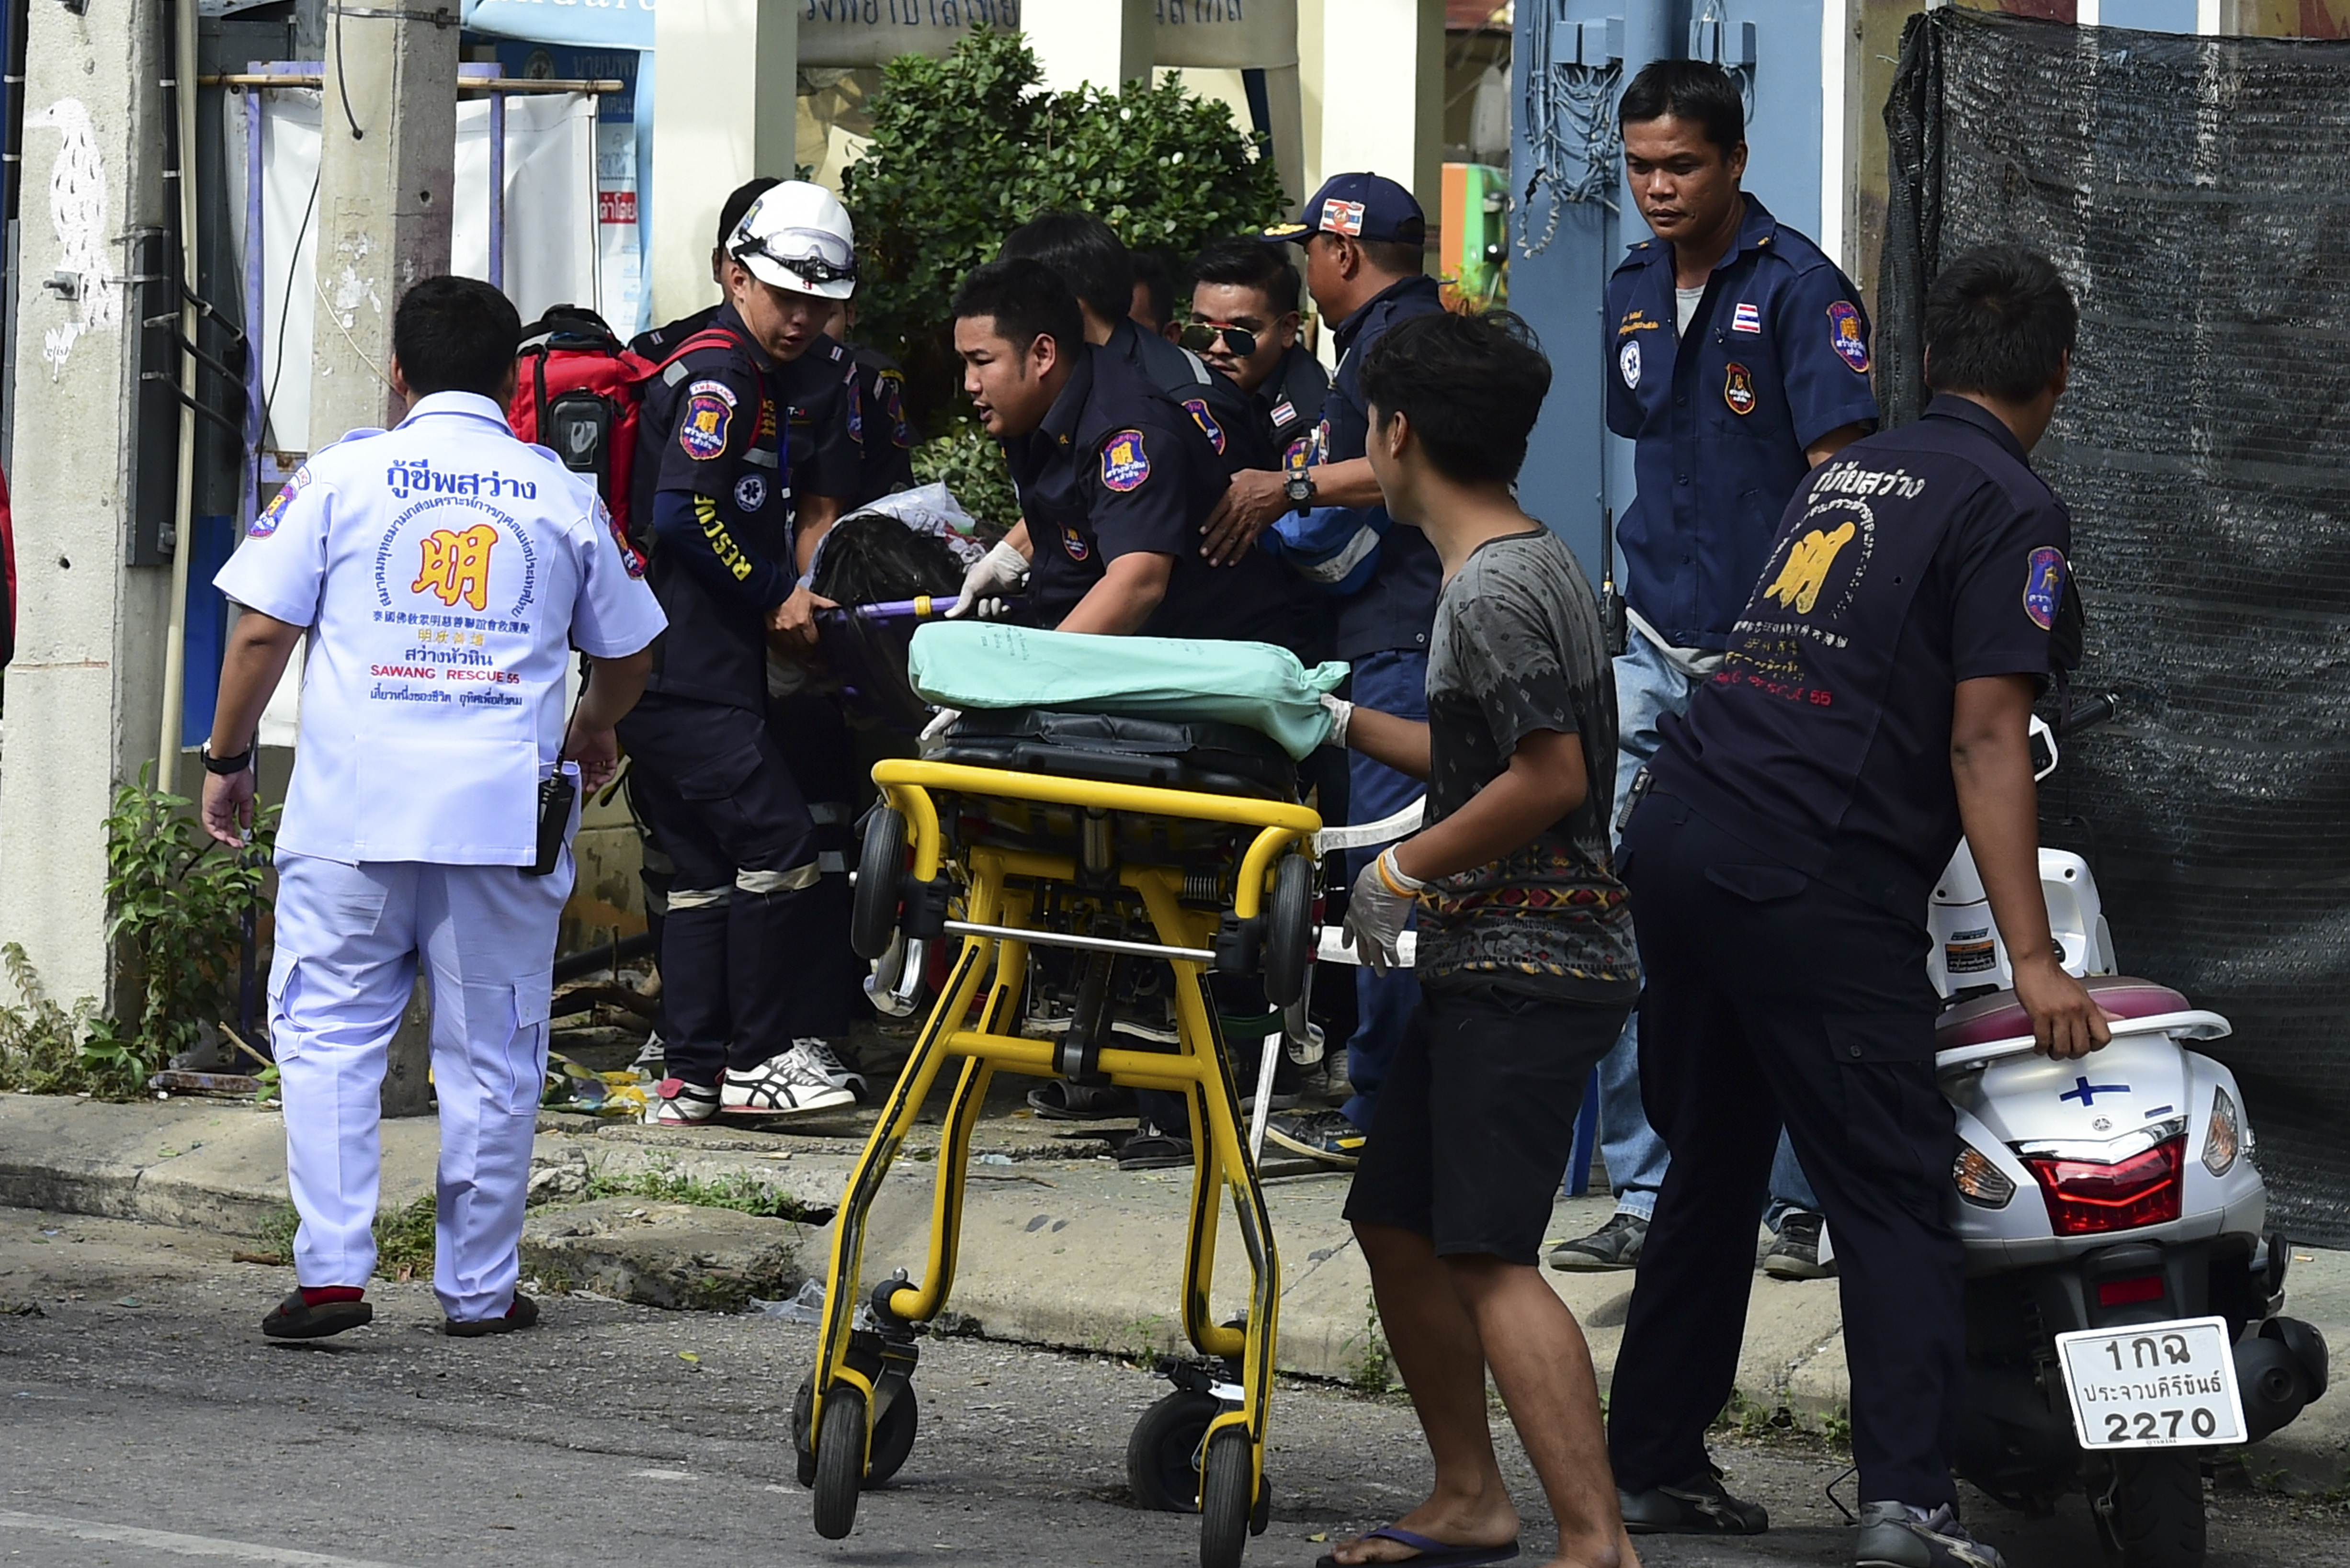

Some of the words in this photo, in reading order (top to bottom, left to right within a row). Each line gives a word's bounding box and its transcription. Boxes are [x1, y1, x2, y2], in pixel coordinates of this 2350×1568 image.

[387, 459, 537, 500] กู้ชีพสว่าง
[405, 645, 493, 666] สว่างหัวหิน
[371, 665, 436, 679] SAWANG
[446, 669, 505, 682] RESCUE
[506, 673, 520, 684] 55
[2084, 1370, 2222, 1402] ประจวบคีรีขันธ์
[2104, 1407, 2216, 1443] 2270
